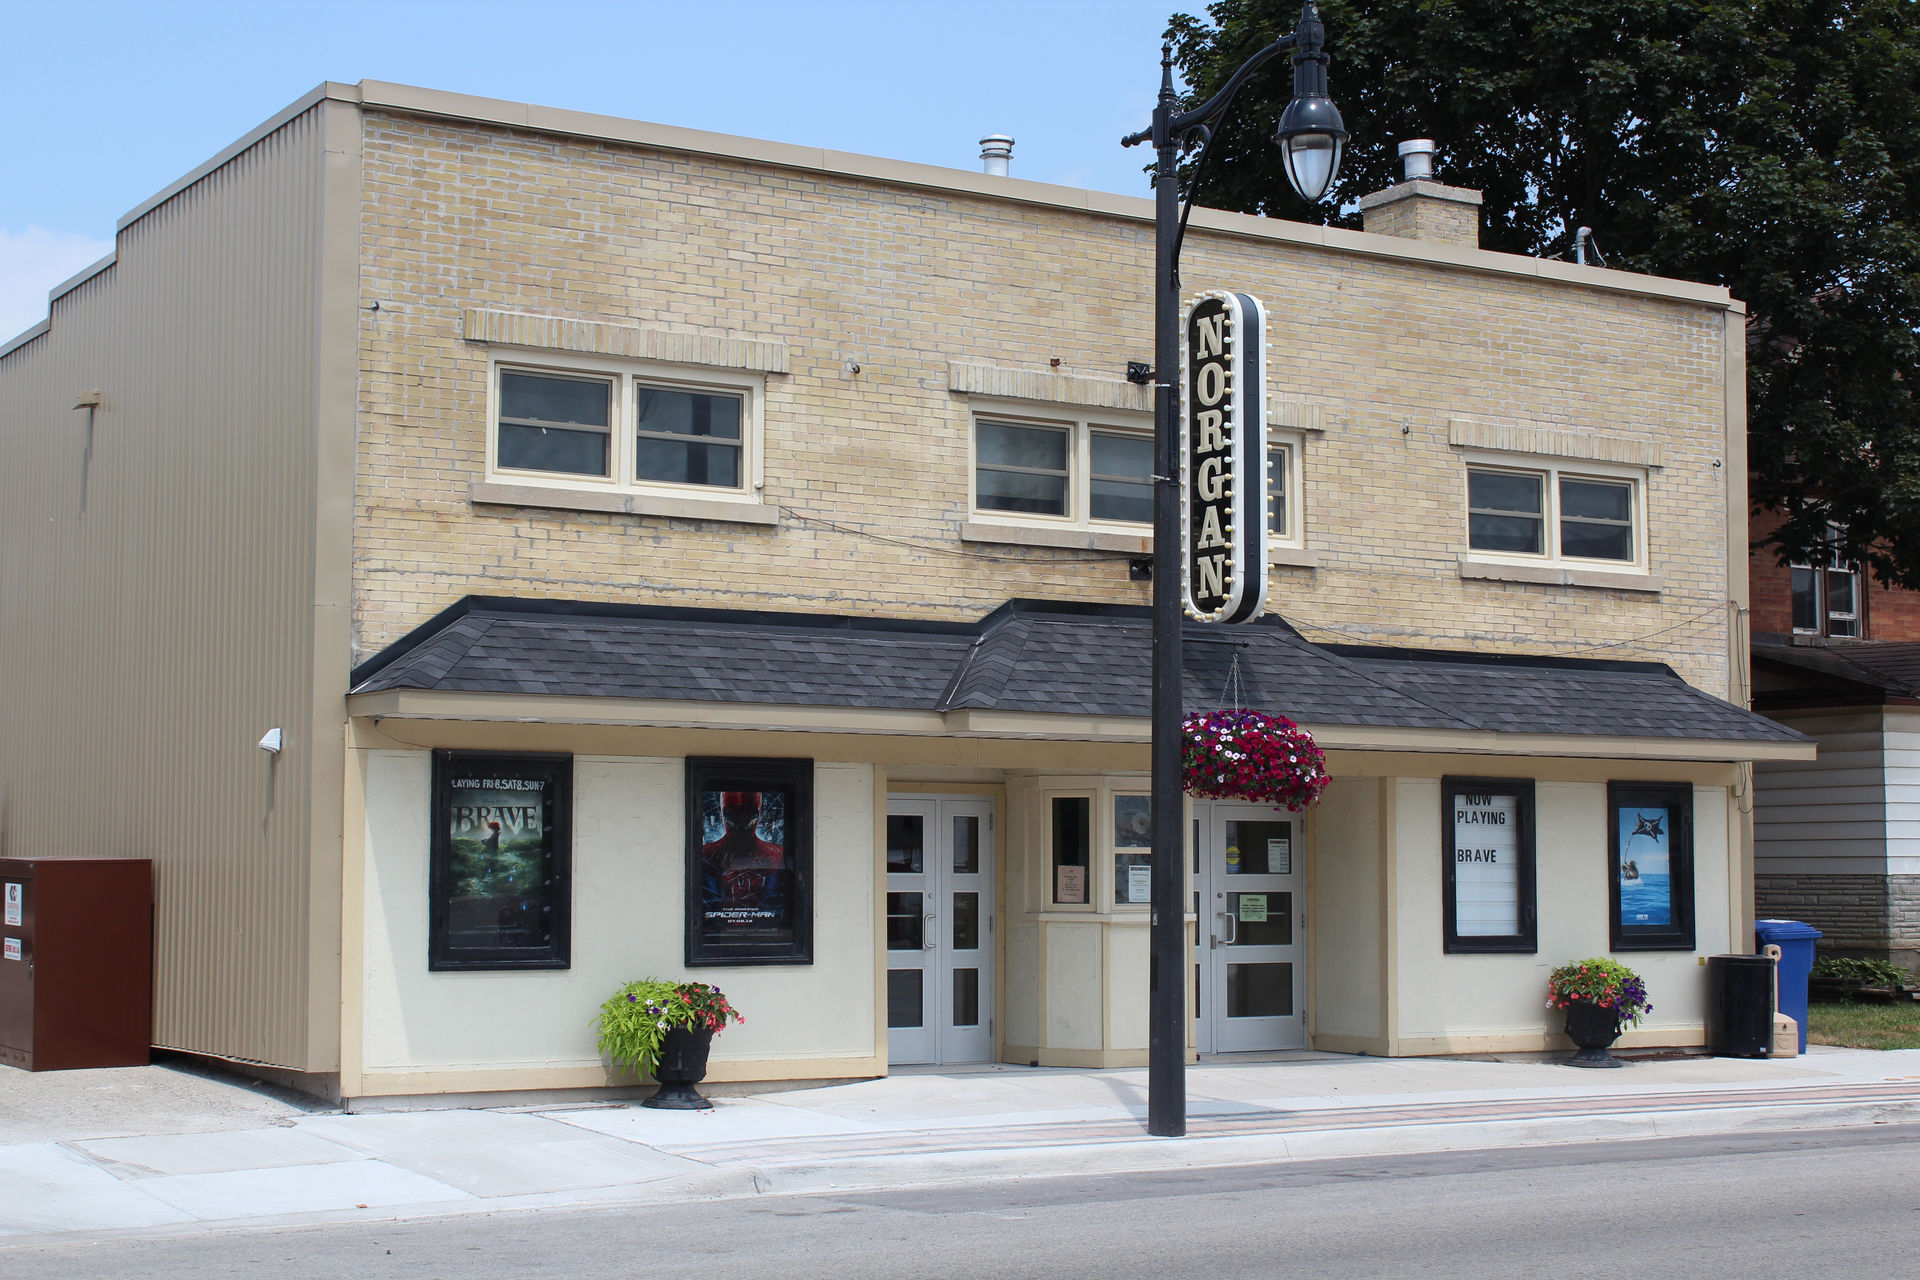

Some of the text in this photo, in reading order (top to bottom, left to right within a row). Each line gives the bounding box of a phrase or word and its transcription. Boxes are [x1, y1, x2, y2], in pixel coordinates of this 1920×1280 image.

[1196, 313, 1227, 599] NORGAN
[451, 779, 480, 788] LAYING
[1465, 794, 1492, 806] NOW
[453, 806, 538, 832] BRAVE
[1457, 810, 1506, 825] PLAYING
[1457, 848, 1497, 863] BRAVE
